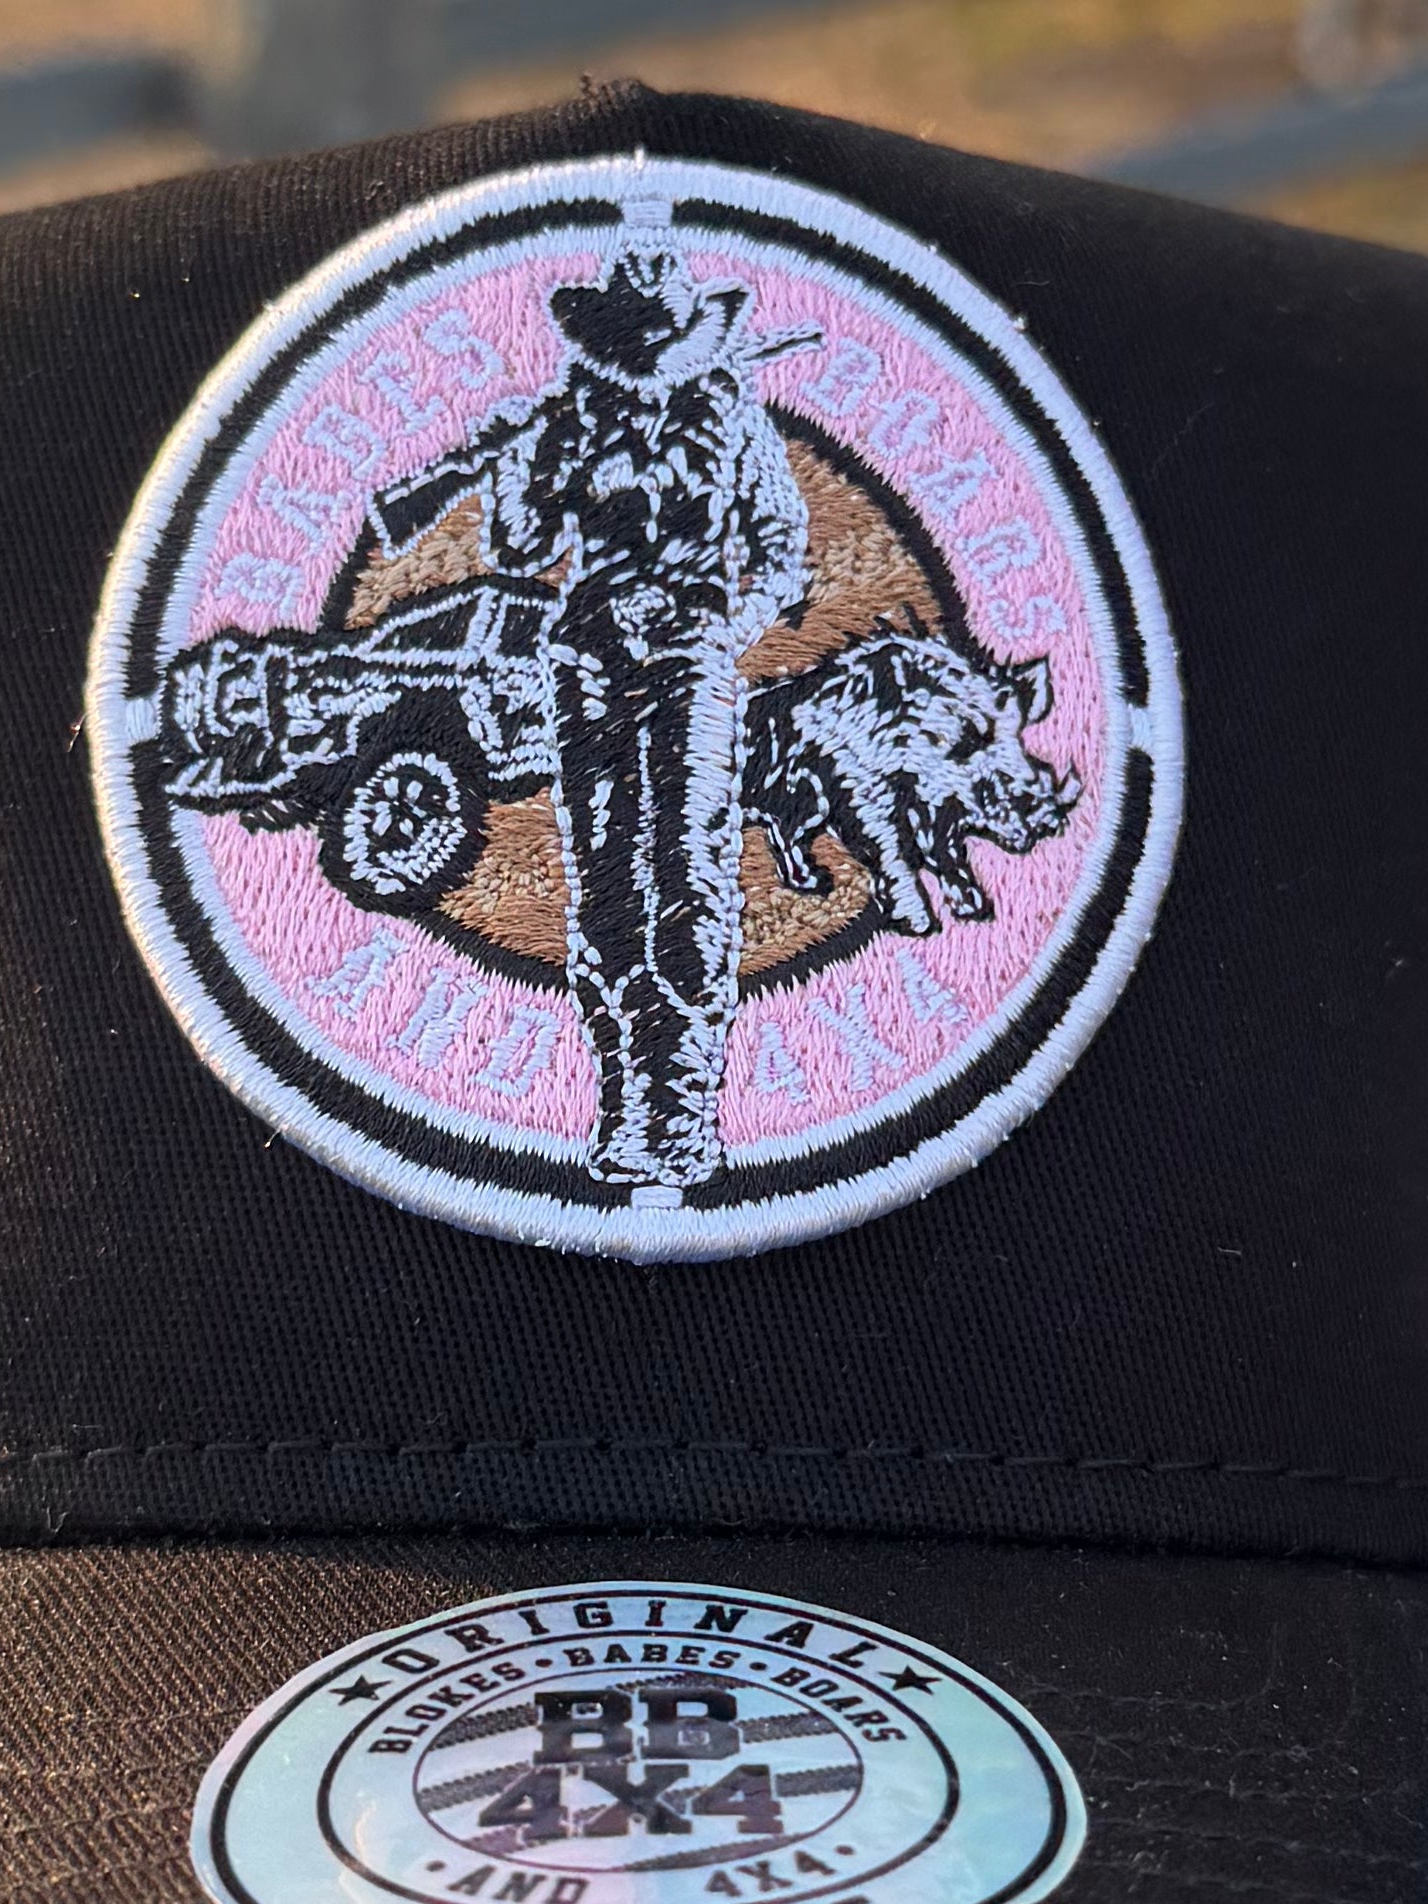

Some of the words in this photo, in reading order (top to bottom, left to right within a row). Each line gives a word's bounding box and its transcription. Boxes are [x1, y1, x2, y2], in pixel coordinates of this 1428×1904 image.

[219, 313, 504, 620] BABES
[799, 345, 1068, 640] BOARS
[306, 938, 559, 1095] AND
[382, 1600, 884, 1674] ORIGINAL
[369, 1659, 524, 1754] BLOKES
[563, 1645, 744, 1667] BABES
[780, 1666, 908, 1743] BOARS
[532, 1688, 740, 1763] BB
[478, 1764, 784, 1839] 4X4
[705, 1851, 837, 1898] 4X4
